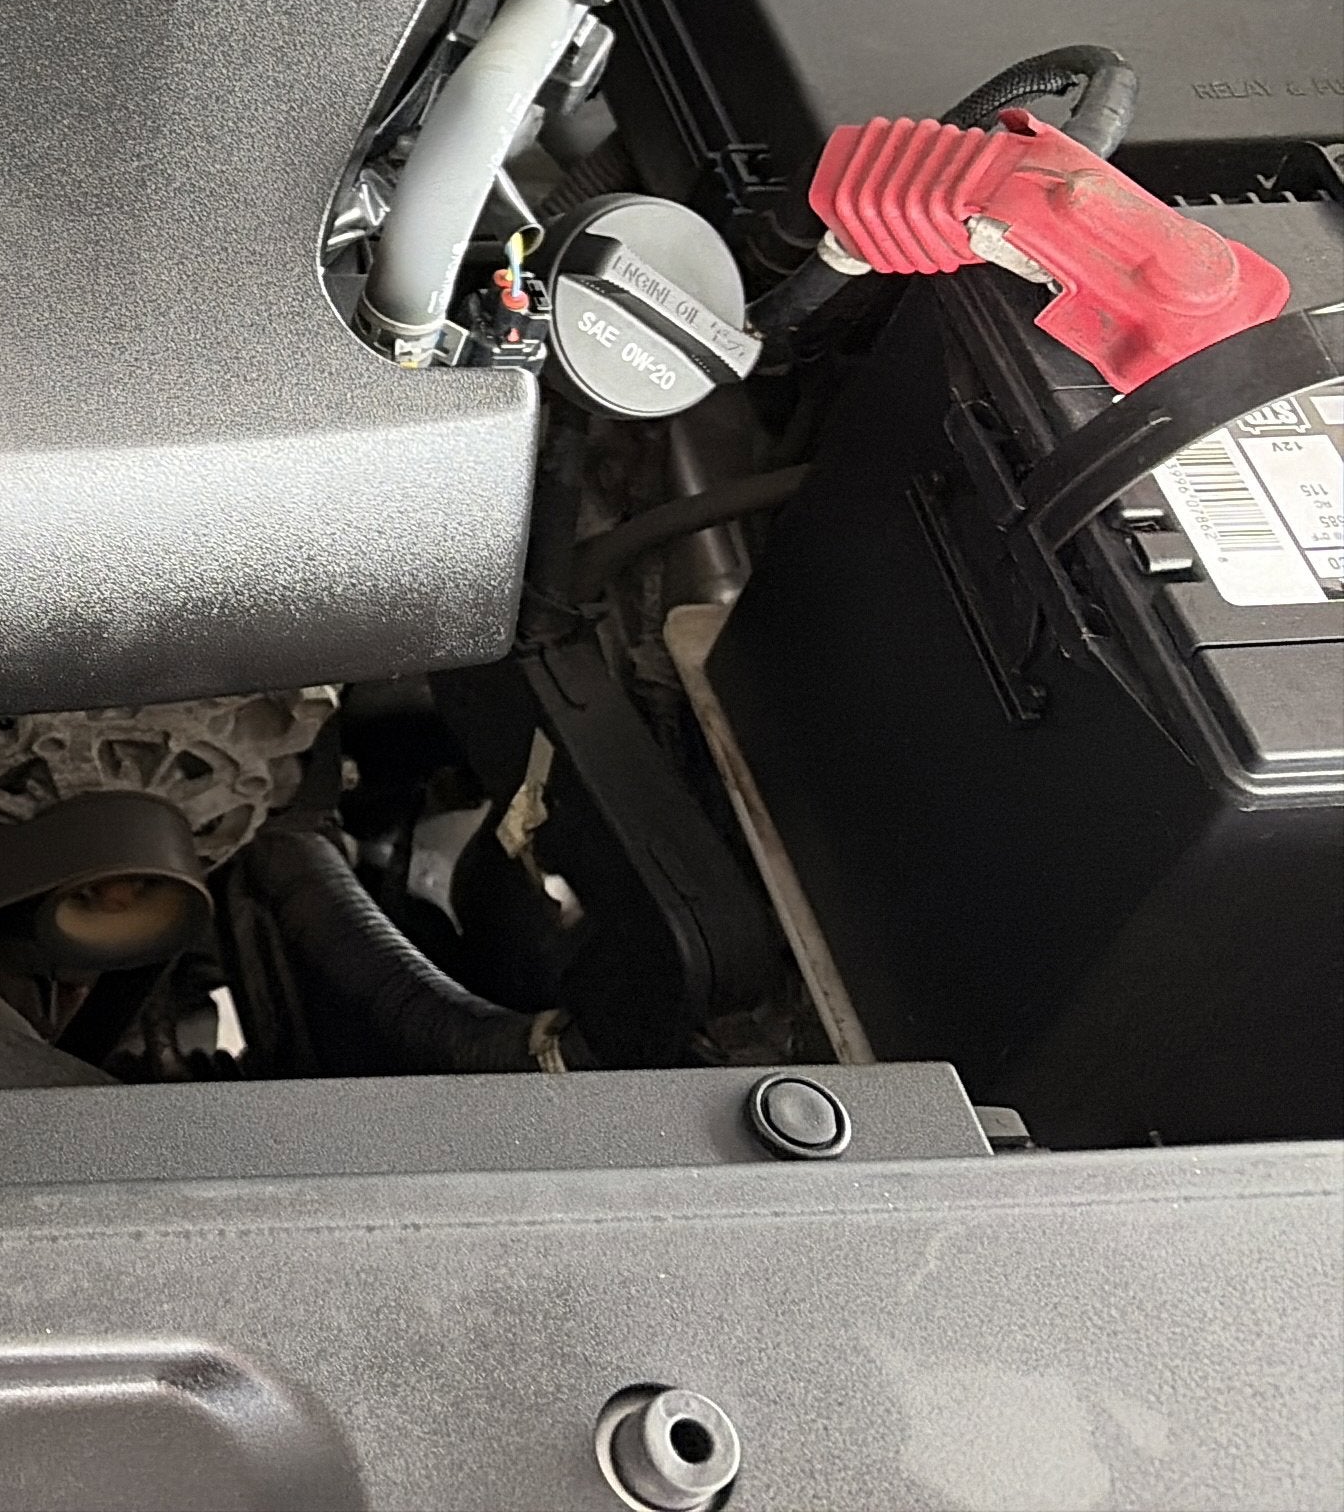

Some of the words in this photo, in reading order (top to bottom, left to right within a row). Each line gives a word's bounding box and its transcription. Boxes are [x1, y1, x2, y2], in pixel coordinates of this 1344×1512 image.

[1191, 79, 1273, 100] RELAY
[612, 254, 672, 307] ENGINE
[675, 300, 699, 329] OIL
[577, 311, 620, 348] SAE
[621, 342, 677, 390] 0W-20
[1271, 441, 1304, 453] 12V
[1299, 483, 1329, 497] 115
